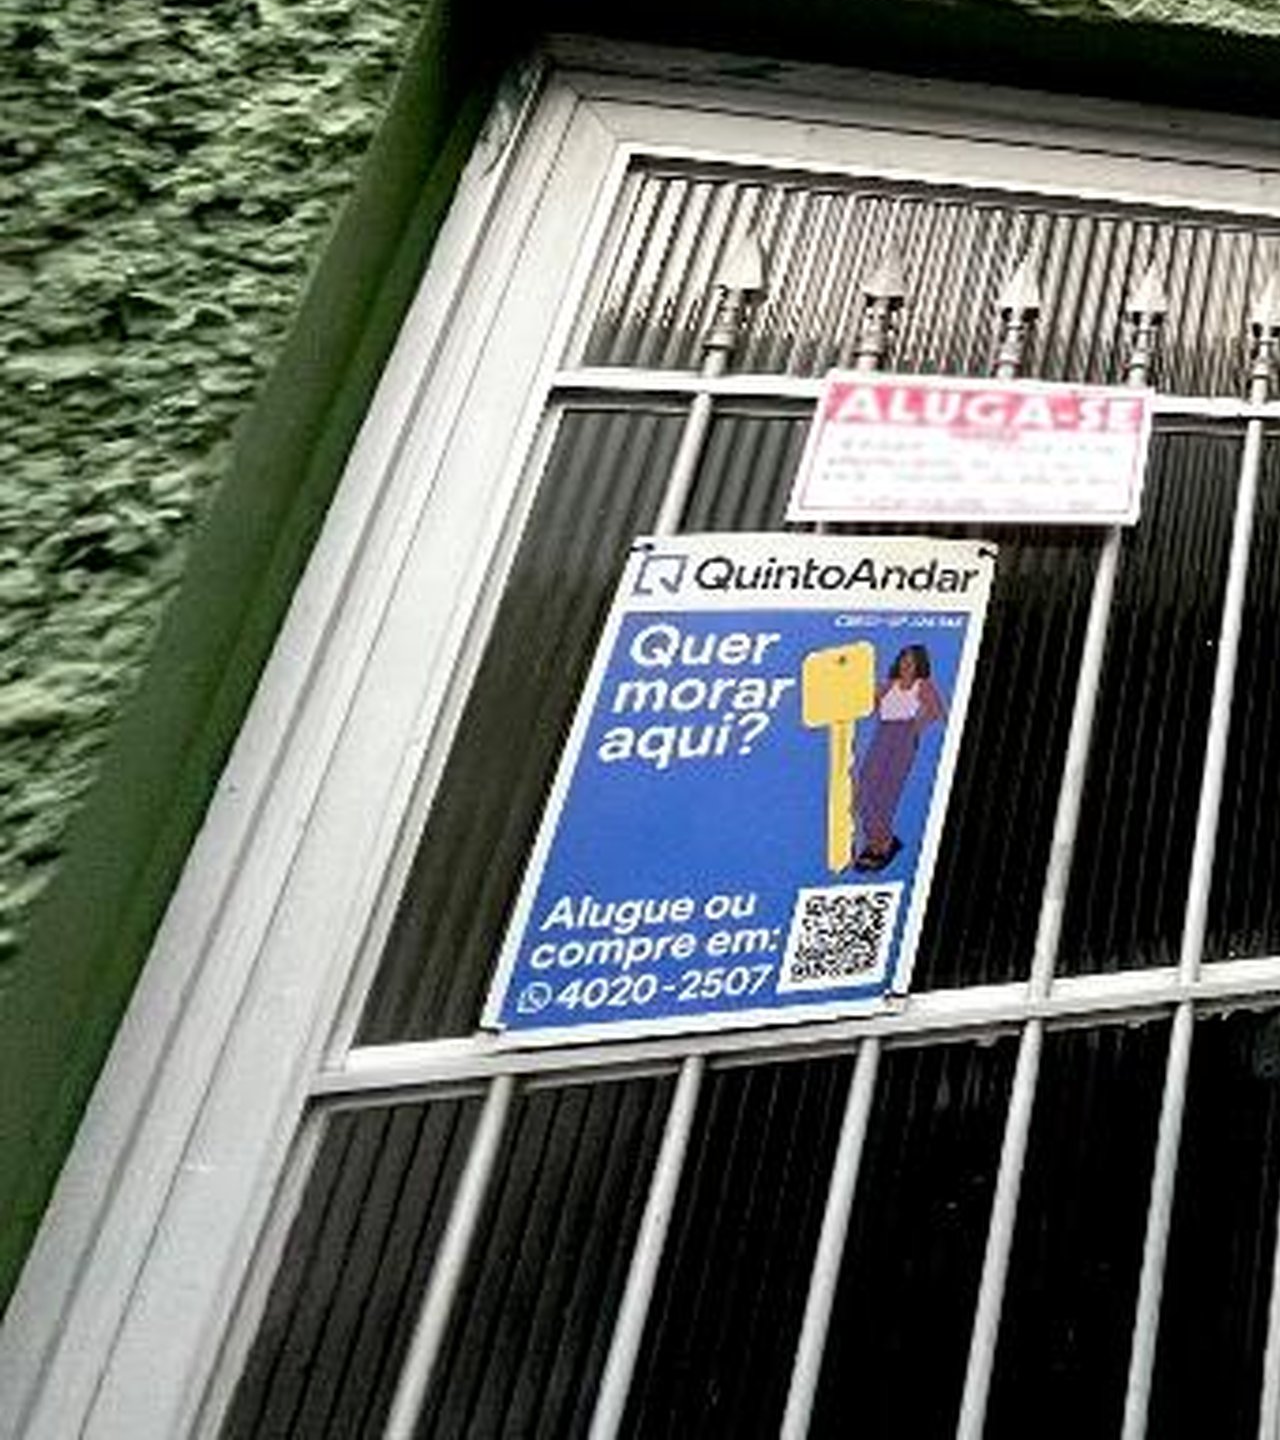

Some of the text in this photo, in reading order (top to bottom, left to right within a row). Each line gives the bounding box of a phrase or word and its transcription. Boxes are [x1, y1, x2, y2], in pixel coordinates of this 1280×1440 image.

[832, 384, 1144, 431] ALUGA-SE
[693, 555, 979, 594] QuintoAndar
[629, 623, 782, 668] Quer
[611, 675, 796, 713] morar
[598, 712, 771, 770] aqui?
[540, 892, 758, 935] Alugue ou
[530, 926, 783, 971] compre em:
[555, 964, 774, 1011] 4020-2507
